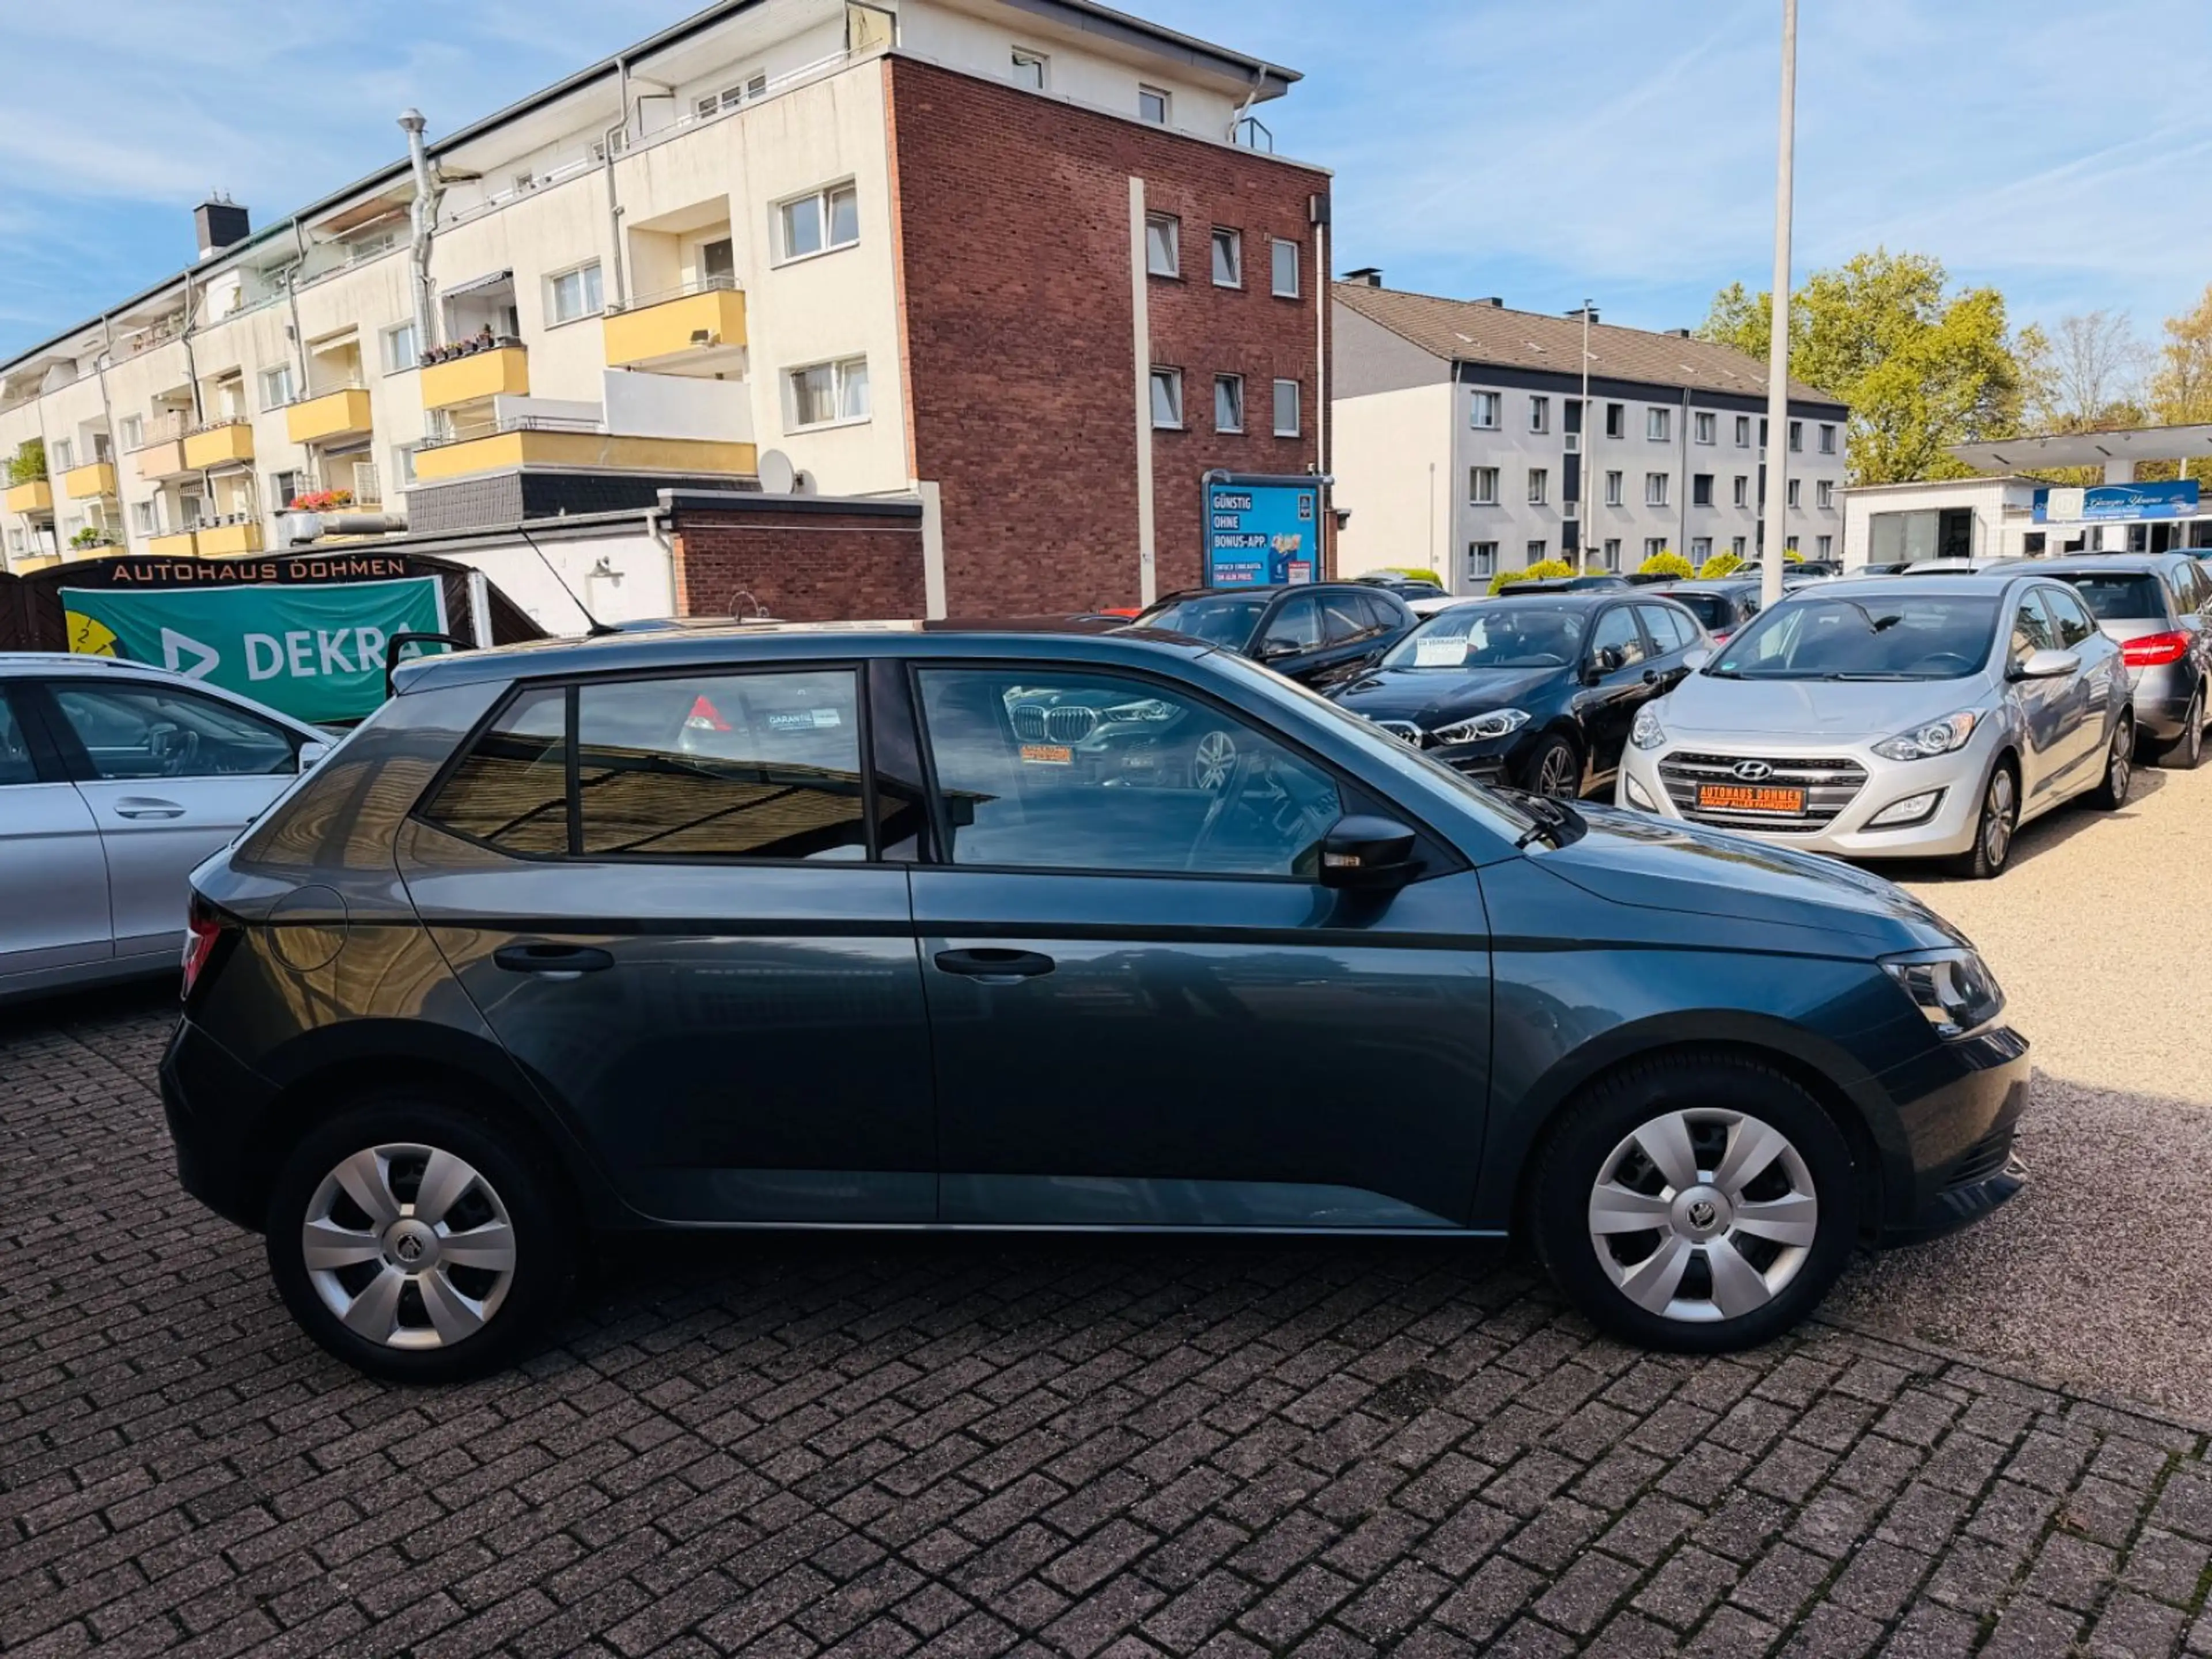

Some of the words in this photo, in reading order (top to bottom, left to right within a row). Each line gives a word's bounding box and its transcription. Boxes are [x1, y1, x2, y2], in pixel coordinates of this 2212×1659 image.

[1214, 493, 1251, 509] GÜNSTIG
[1214, 516, 1238, 528] OHNE
[1214, 535, 1267, 547] BONUS-APP.
[112, 564, 278, 581] AUTOHAUS
[290, 559, 404, 579] DOHMEN
[77, 628, 89, 643] 2
[243, 622, 425, 680] DEKRA
[1700, 786, 1753, 798] AUTOHAUS
[1758, 788, 1802, 801] DOHMEN
